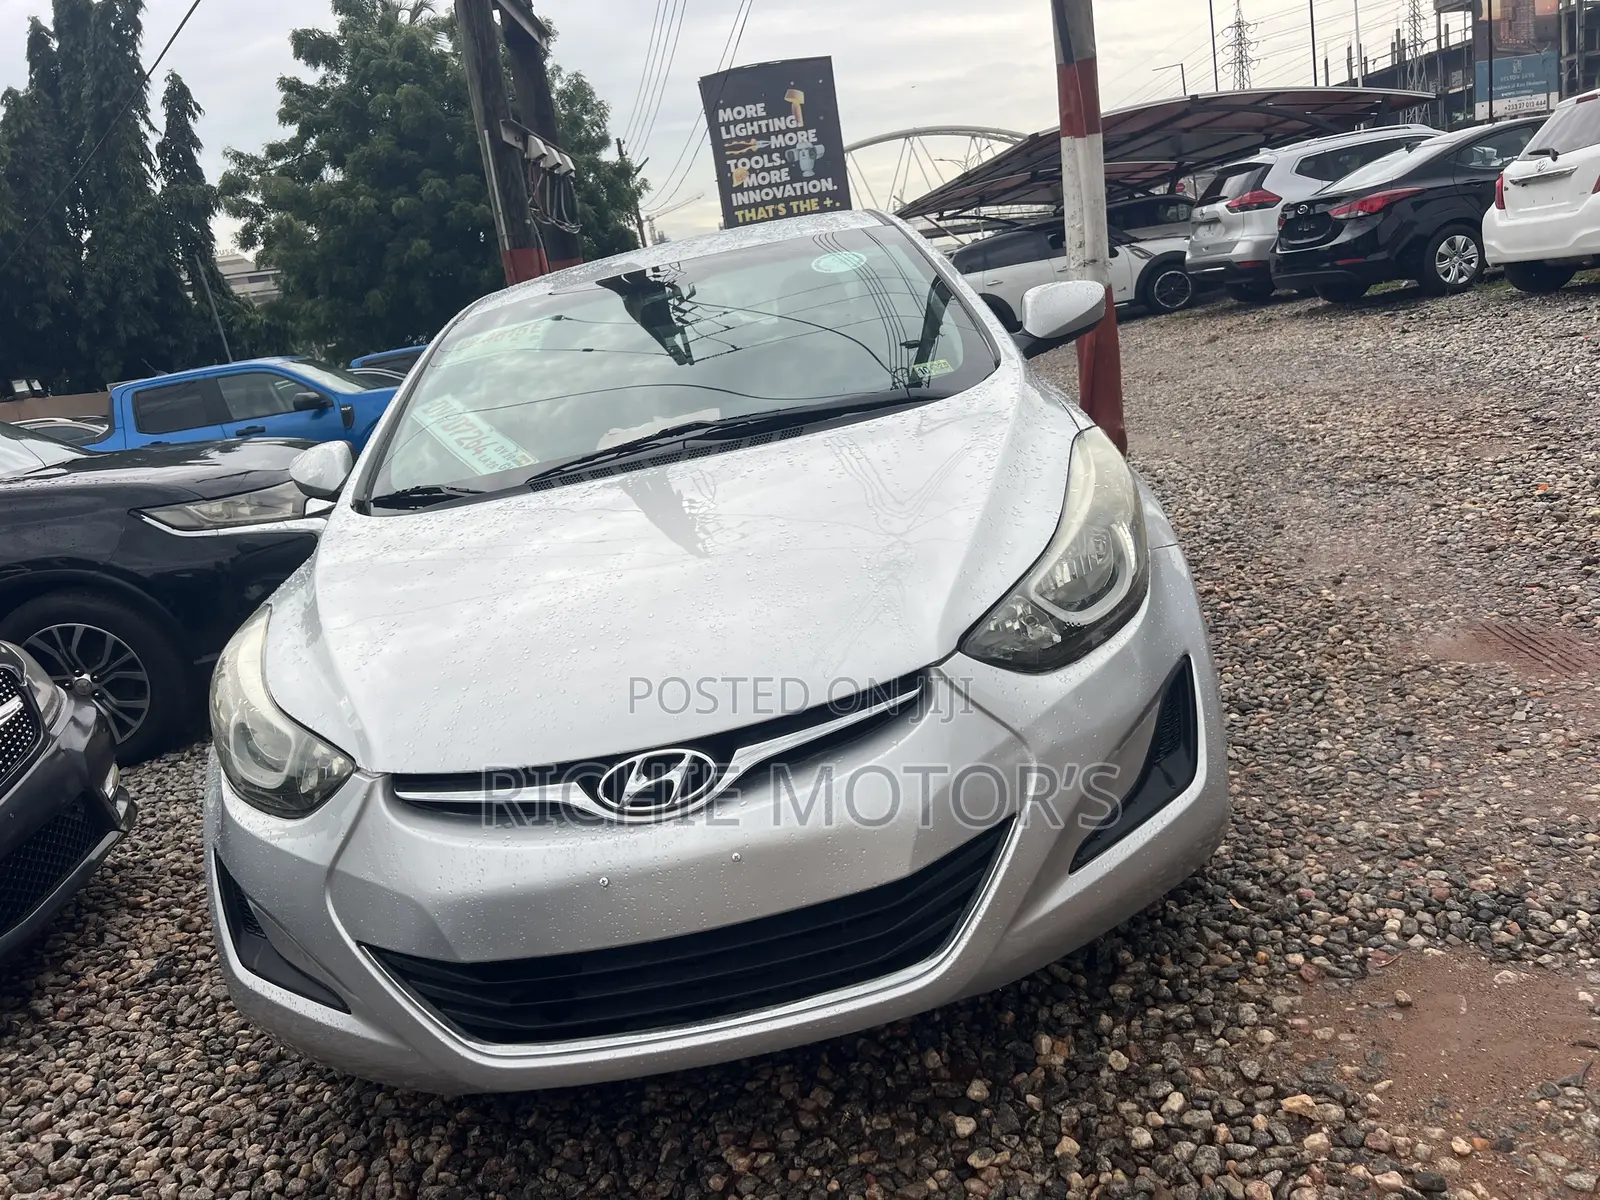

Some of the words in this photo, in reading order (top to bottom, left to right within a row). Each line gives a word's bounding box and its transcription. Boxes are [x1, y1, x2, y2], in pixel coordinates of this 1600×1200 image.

[718, 102, 767, 123] MORE
[770, 129, 818, 149] MORE
[726, 152, 786, 173] TOOLS.
[743, 168, 791, 188] MORE
[731, 177, 838, 207] INNOVATION.
[735, 203, 788, 223] THAT'S
[789, 198, 820, 214] THE
